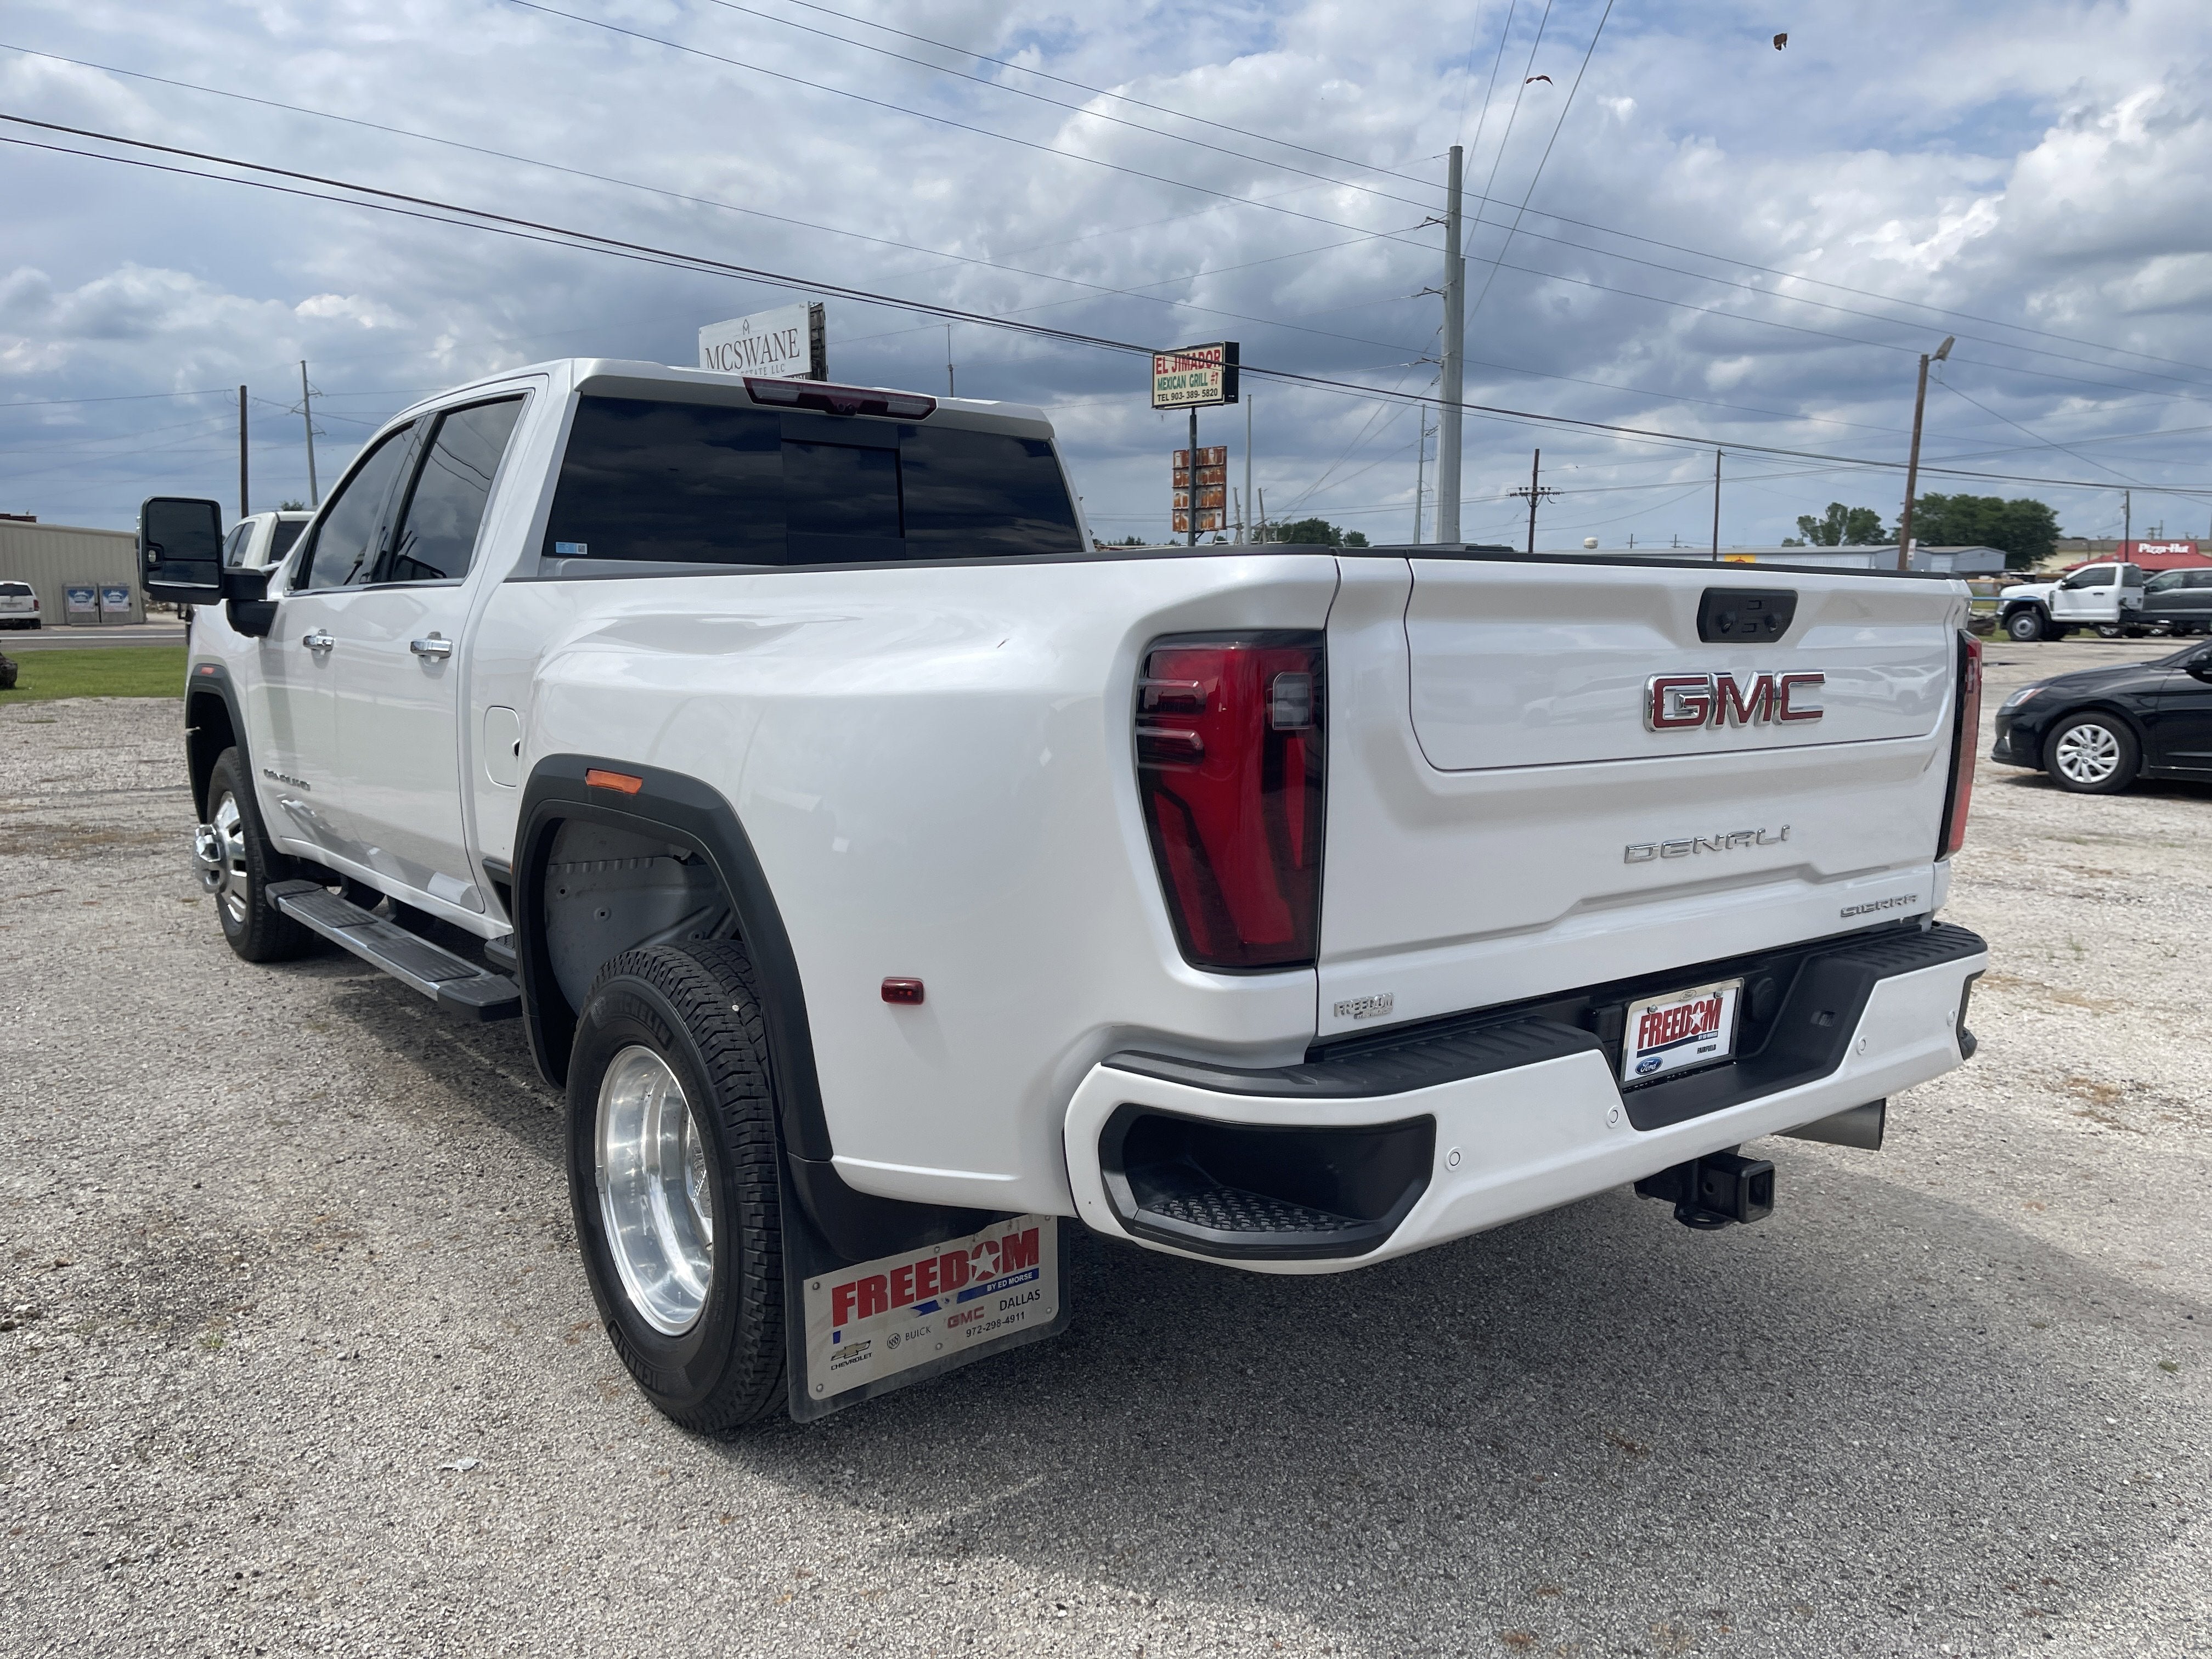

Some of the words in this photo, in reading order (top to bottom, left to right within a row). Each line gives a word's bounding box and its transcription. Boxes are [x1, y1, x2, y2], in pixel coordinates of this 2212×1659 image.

[705, 328, 800, 371] MCSWANE
[741, 367, 768, 376] TATE
[771, 363, 785, 374] LLC
[1156, 356, 1169, 375] EL
[1171, 349, 1221, 373] JIMADOR
[1157, 374, 1186, 391] MEXICAN
[1189, 372, 1208, 388] GRILL
[1211, 371, 1219, 386] #7
[1157, 393, 1170, 402] TEL
[1201, 388, 1218, 398] 5820
[1643, 669, 1826, 733] GMC
[1624, 824, 1791, 864] DENALI
[1840, 893, 1918, 917] SIERRA
[1334, 992, 1395, 1017] FREEDOM
[1637, 997, 1724, 1050] FREEDOM
[1640, 1060, 1657, 1073] Ford
[832, 1227, 1039, 1328] FREEDOM
[987, 1282, 997, 1291] BY
[998, 1280, 1007, 1289] ED
[1008, 1272, 1033, 1285] MORSE
[1000, 1289, 1040, 1311] DALLAS
[947, 1306, 985, 1329] GMC
[966, 1311, 1025, 1338] 972-298-4911
[905, 1325, 932, 1341] BUICK
[831, 1352, 873, 1370] CHEVROLET
